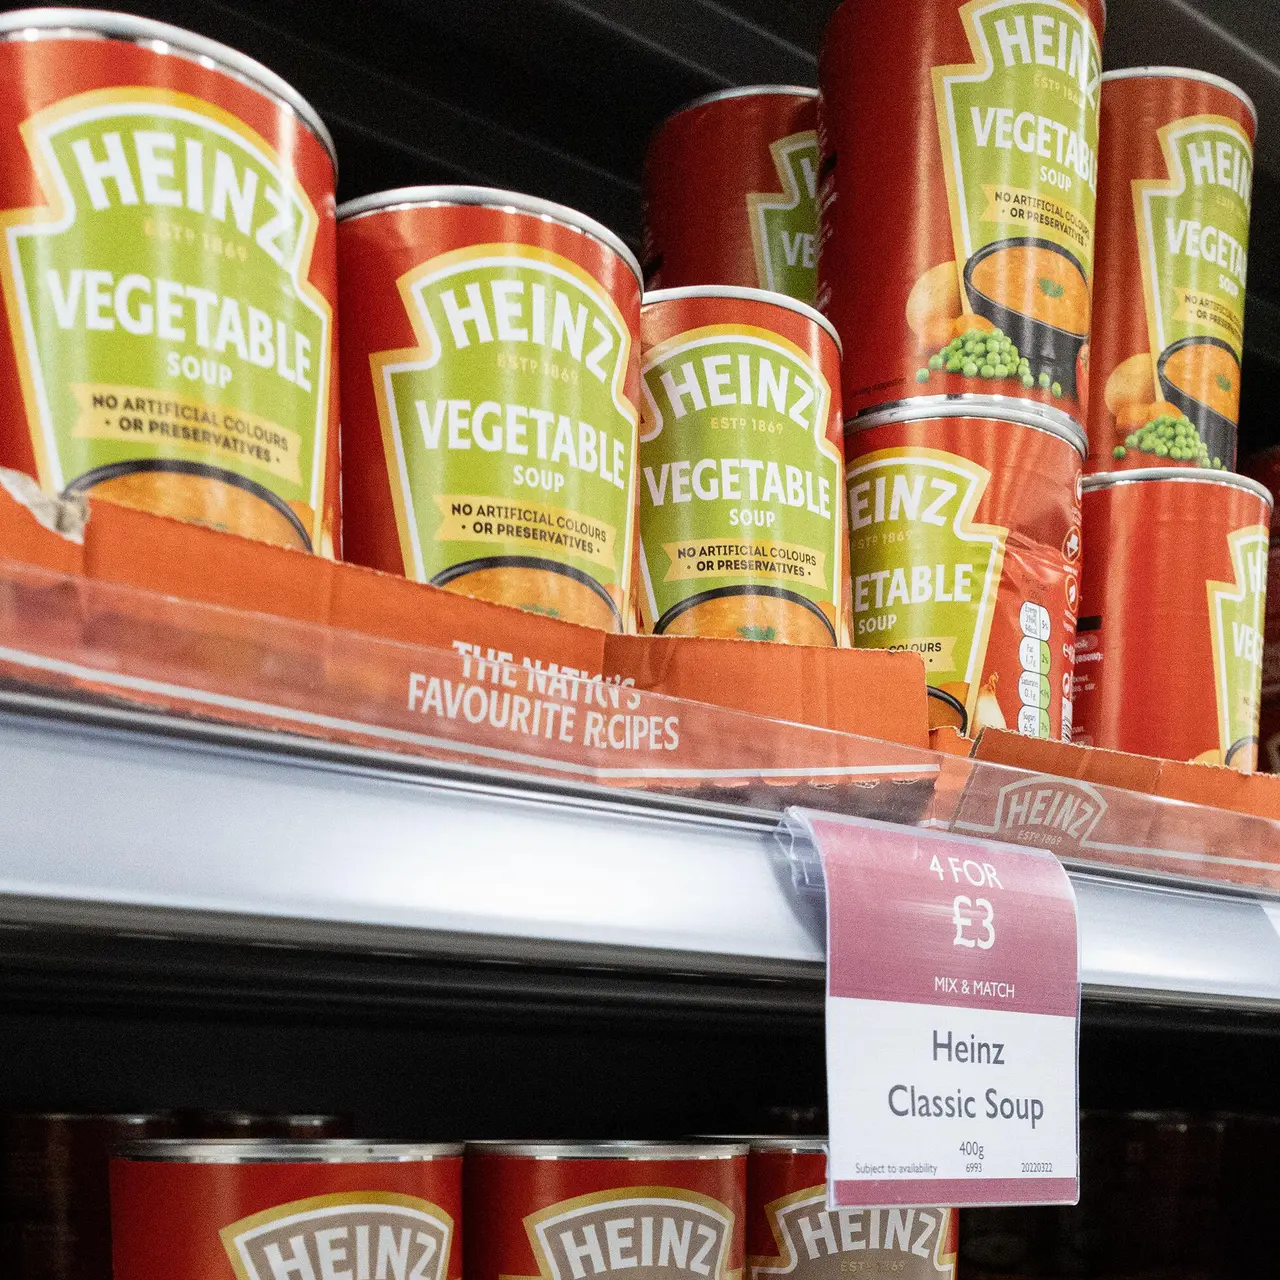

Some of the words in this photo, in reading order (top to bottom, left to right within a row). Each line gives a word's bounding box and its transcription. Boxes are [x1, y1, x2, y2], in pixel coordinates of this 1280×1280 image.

[70, 130, 298, 264] HEINZ
[1040, 165, 1072, 192] SOUP
[995, 191, 1011, 202] NO
[1013, 194, 1064, 219] ARTIFICIAL
[1010, 208, 1025, 220] OR
[1026, 211, 1085, 247] PRESERVATIVES
[46, 268, 313, 393] VEGETABLE
[438, 280, 614, 384] HEINZ
[659, 357, 816, 431] HEINZ
[415, 400, 626, 490] VEGETABLE
[513, 466, 565, 494] SOUP
[643, 457, 831, 519] VEGETABLE
[849, 474, 957, 531] EINZ
[729, 509, 776, 528] SOUP
[453, 640, 518, 688] THE
[409, 672, 576, 743] FAVOURITE
[1007, 789, 1093, 836] HEINZ
[1041, 833, 1063, 846] 1869
[930, 855, 944, 882] 4
[949, 857, 1004, 890] FOR
[952, 895, 996, 950] £3
[934, 977, 959, 994] MIX
[961, 980, 970, 995] &
[973, 981, 1016, 999] MATCH
[932, 1029, 1006, 1066] Heinz
[887, 1084, 977, 1119] Classic
[985, 1088, 1044, 1129] Soup
[855, 1163, 885, 1175] Subject
[888, 1164, 897, 1174] to
[898, 1162, 938, 1175] availability
[959, 1141, 985, 1160] 400g
[966, 1163, 983, 1173] 6993
[1021, 1162, 1053, 1173] 20220322
[559, 1216, 716, 1280] HEINZ
[798, 1209, 937, 1260] HEINZ
